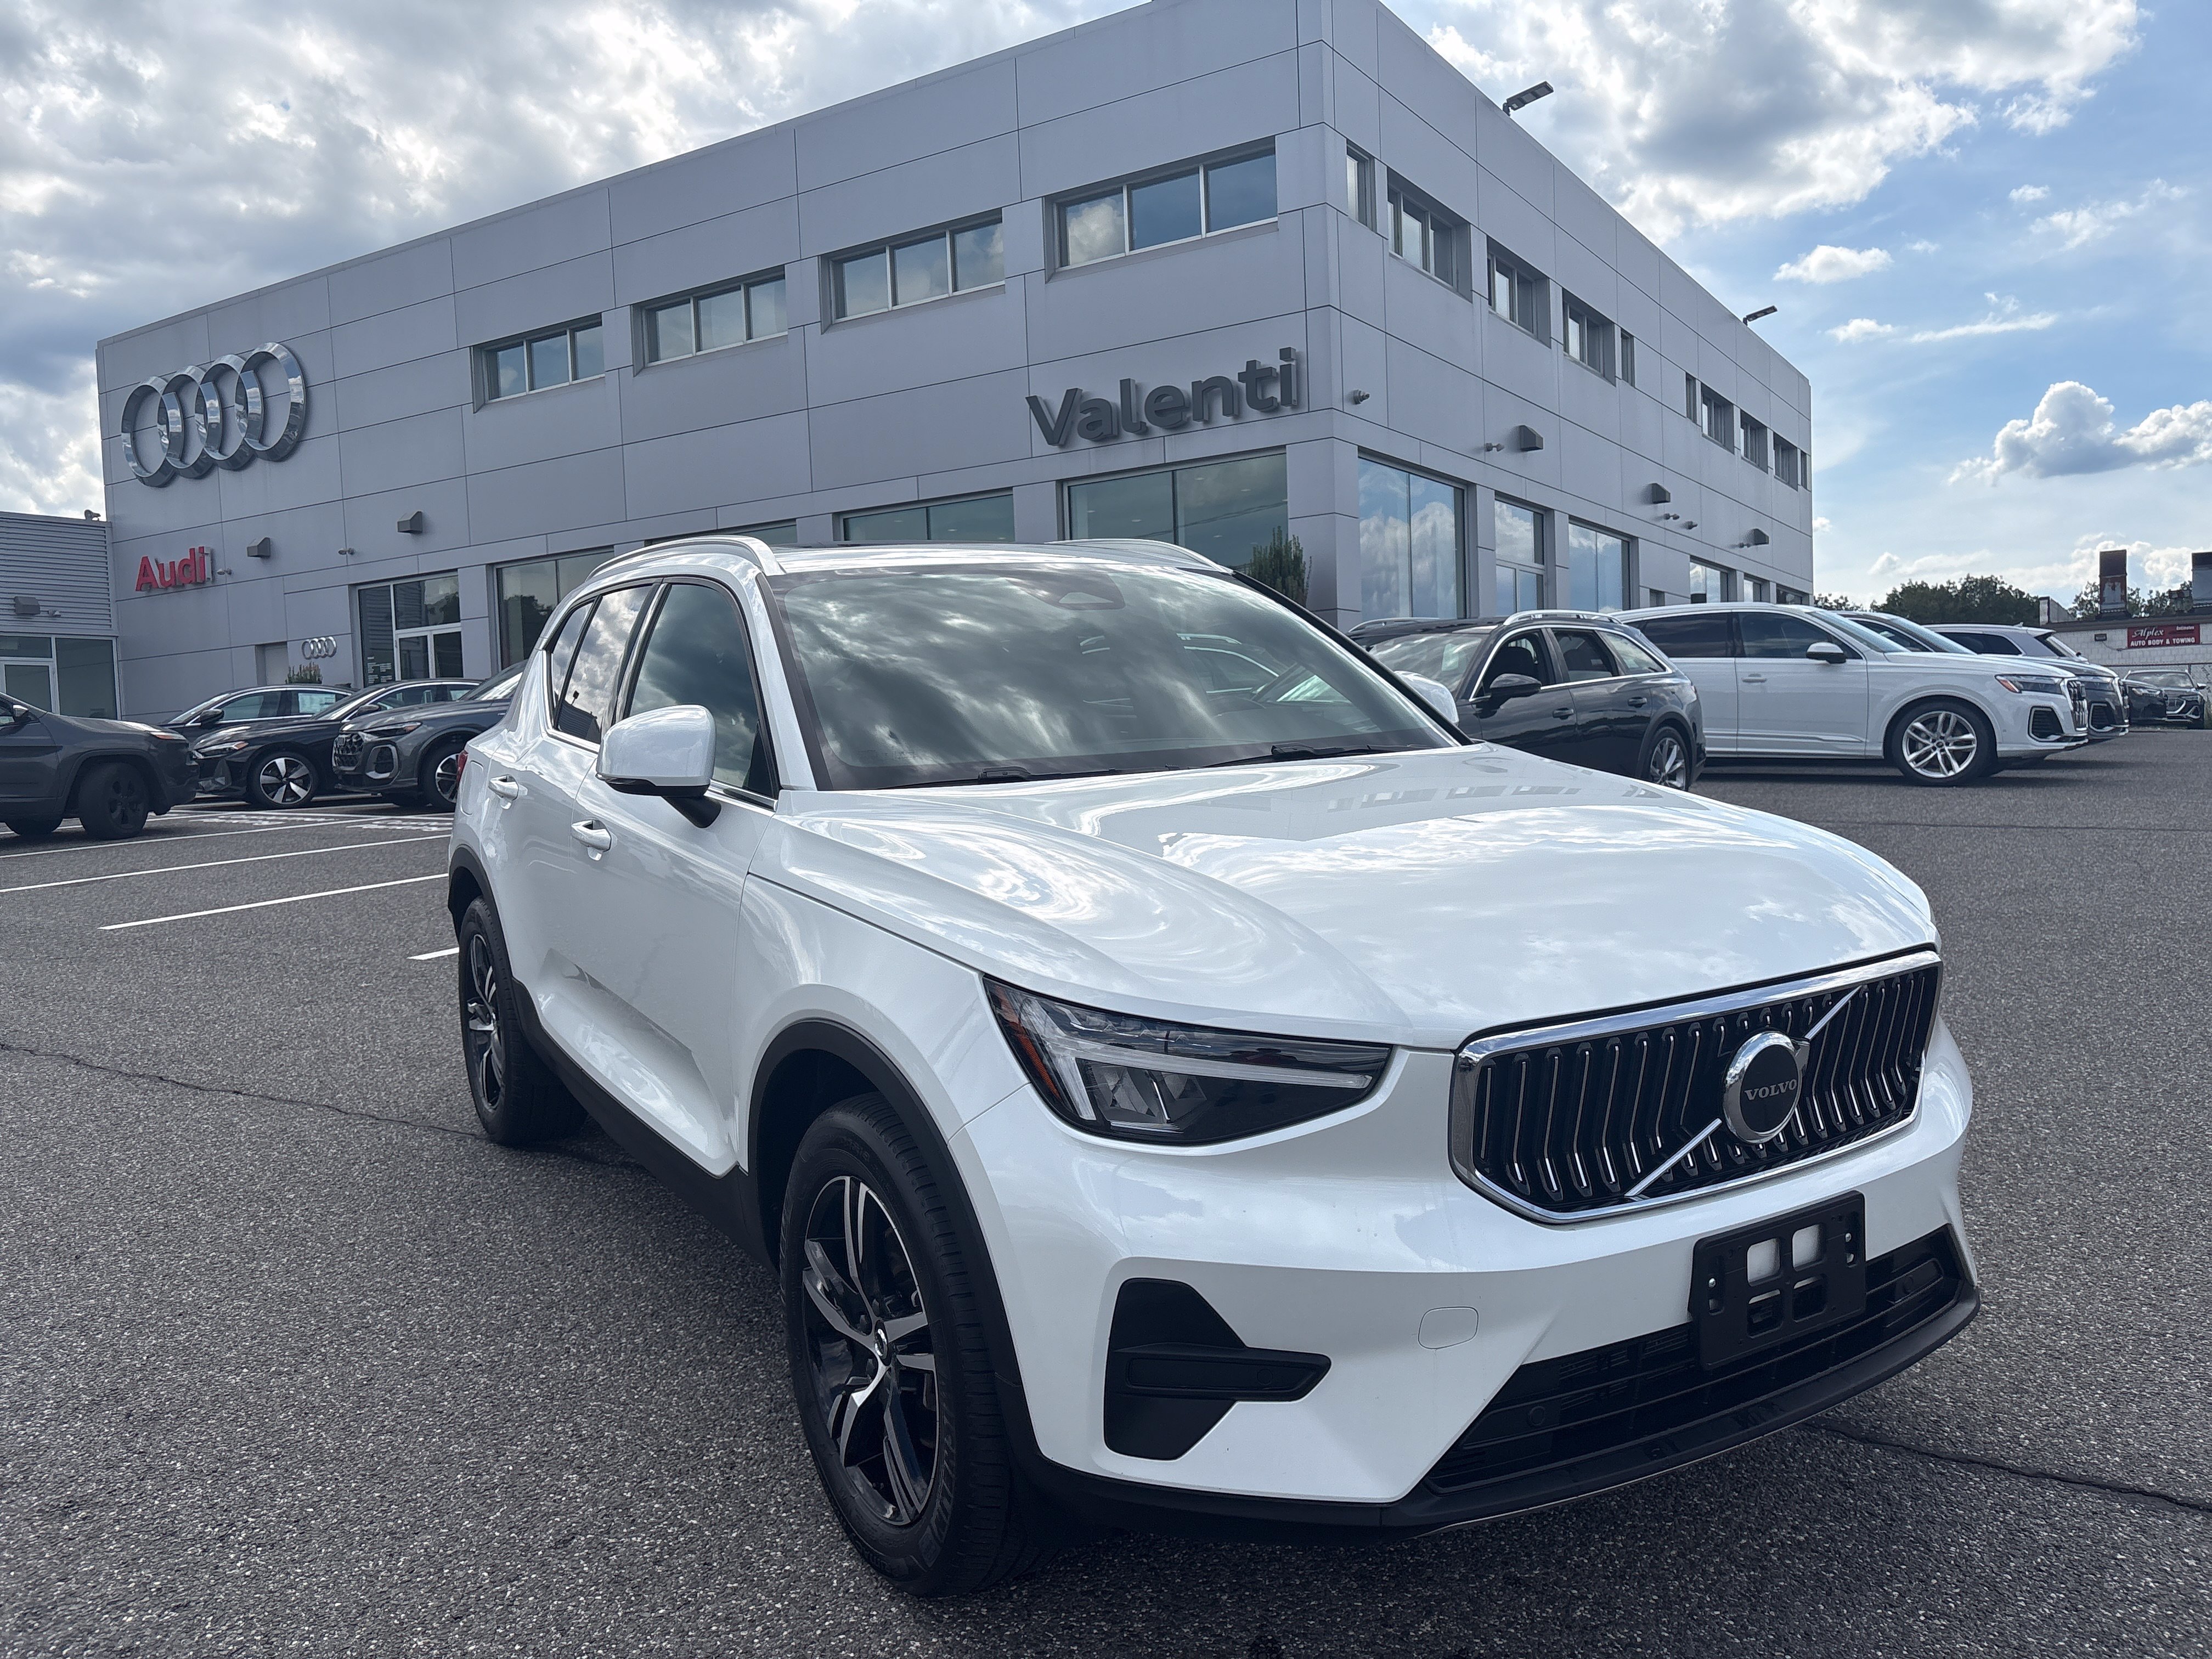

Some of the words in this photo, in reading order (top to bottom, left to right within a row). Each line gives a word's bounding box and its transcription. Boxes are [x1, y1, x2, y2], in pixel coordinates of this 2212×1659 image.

[1025, 346, 1297, 446] Valenti
[135, 546, 207, 592] Audi
[1744, 1079, 1797, 1101] VOLVO
